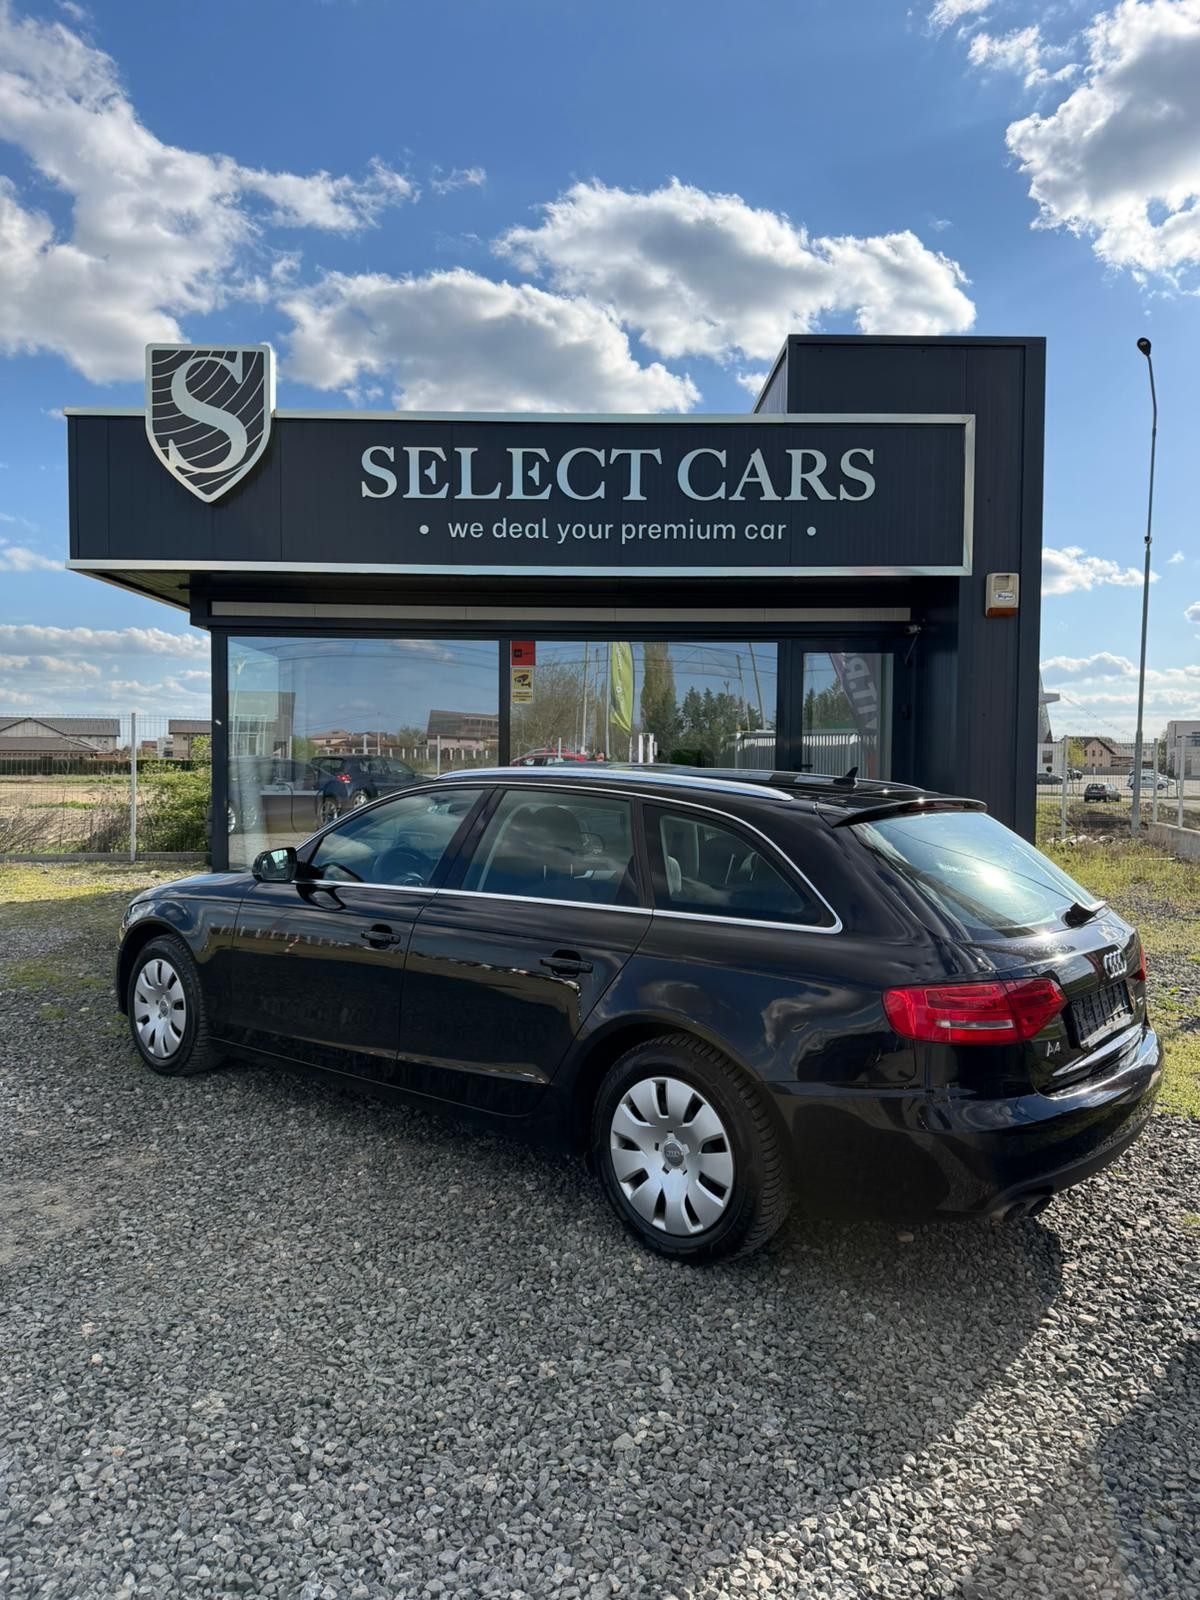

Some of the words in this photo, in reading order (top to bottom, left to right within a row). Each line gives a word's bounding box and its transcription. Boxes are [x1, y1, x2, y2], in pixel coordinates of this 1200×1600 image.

[168, 351, 248, 474] S
[361, 445, 662, 501] SELECT
[677, 447, 876, 502] CARS
[447, 522, 484, 539] we
[492, 517, 549, 539] deal
[557, 523, 614, 545] your
[621, 518, 736, 545] premium
[744, 523, 787, 540] car
[1046, 1041, 1061, 1057] A4
